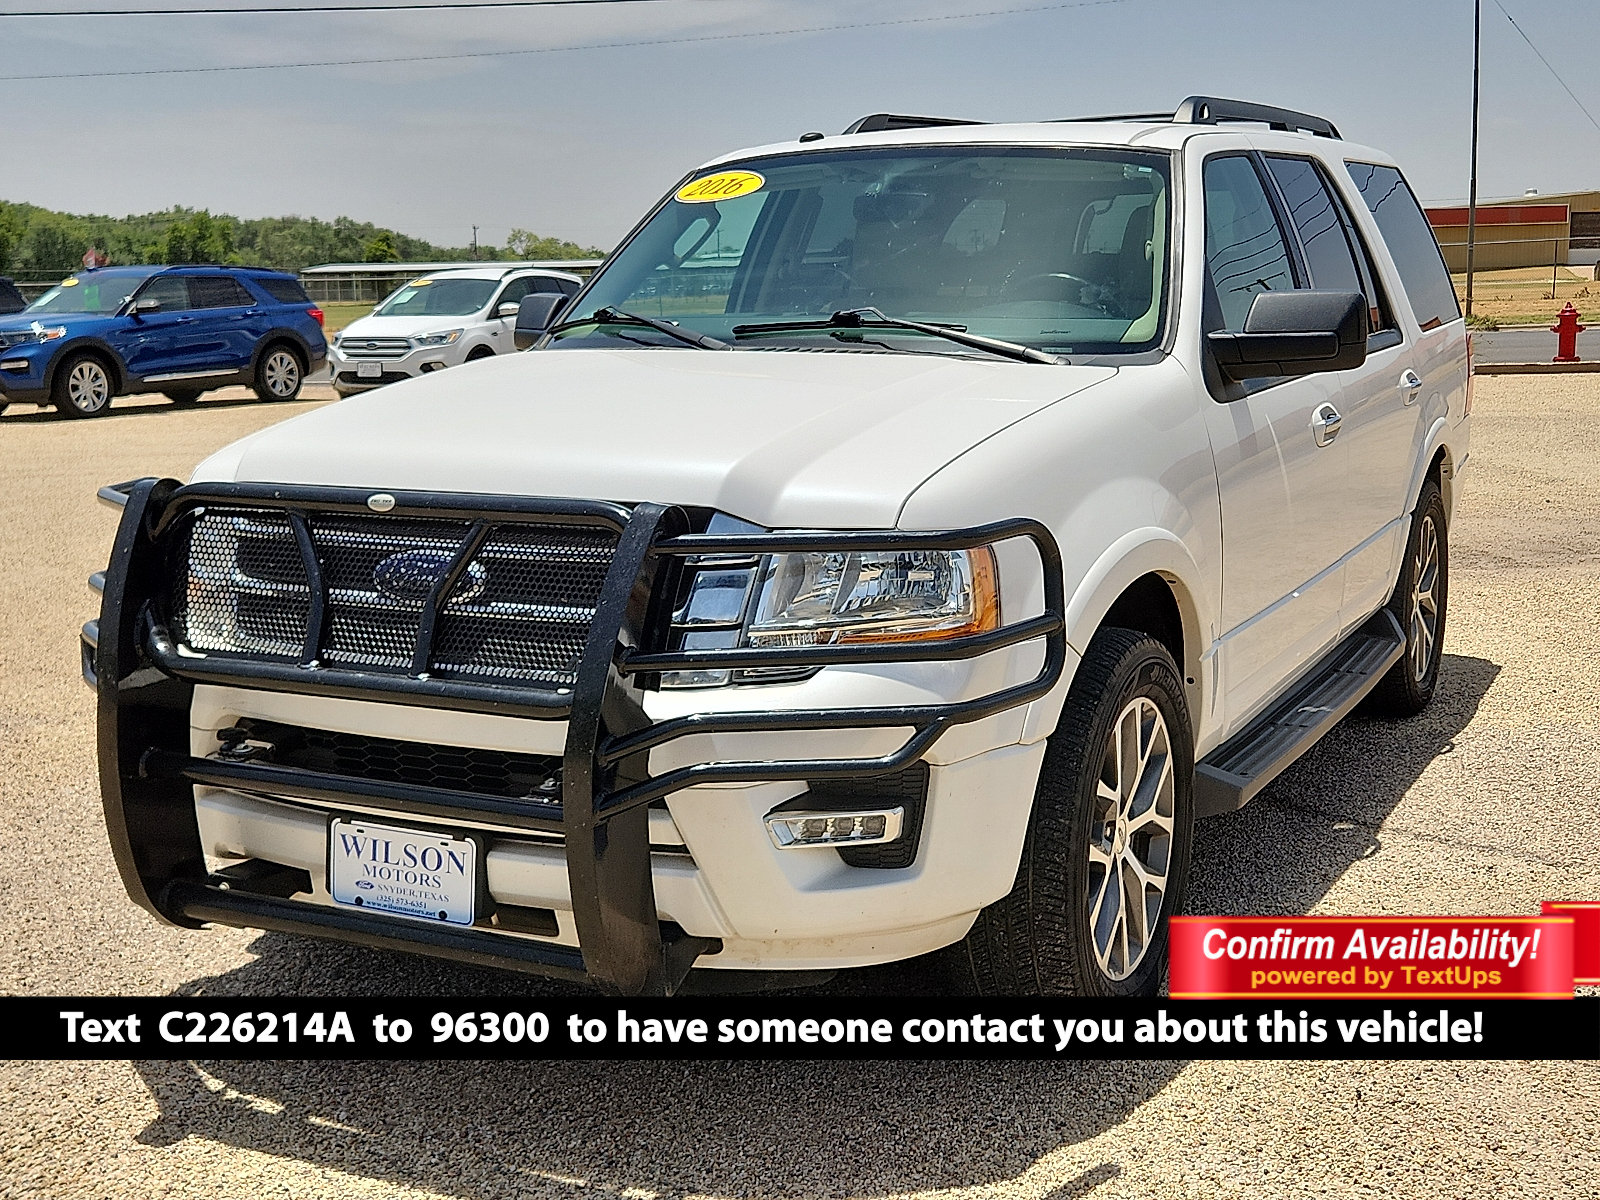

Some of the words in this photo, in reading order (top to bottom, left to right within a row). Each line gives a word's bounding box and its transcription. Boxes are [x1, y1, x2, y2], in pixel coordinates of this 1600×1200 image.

[683, 177, 755, 197] 2016
[340, 833, 467, 876] WILSON
[362, 863, 442, 889] MOTORS
[366, 900, 436, 917] www.wilsonmotors.net
[376, 895, 394, 904] (325)
[395, 897, 427, 909] 573-6351
